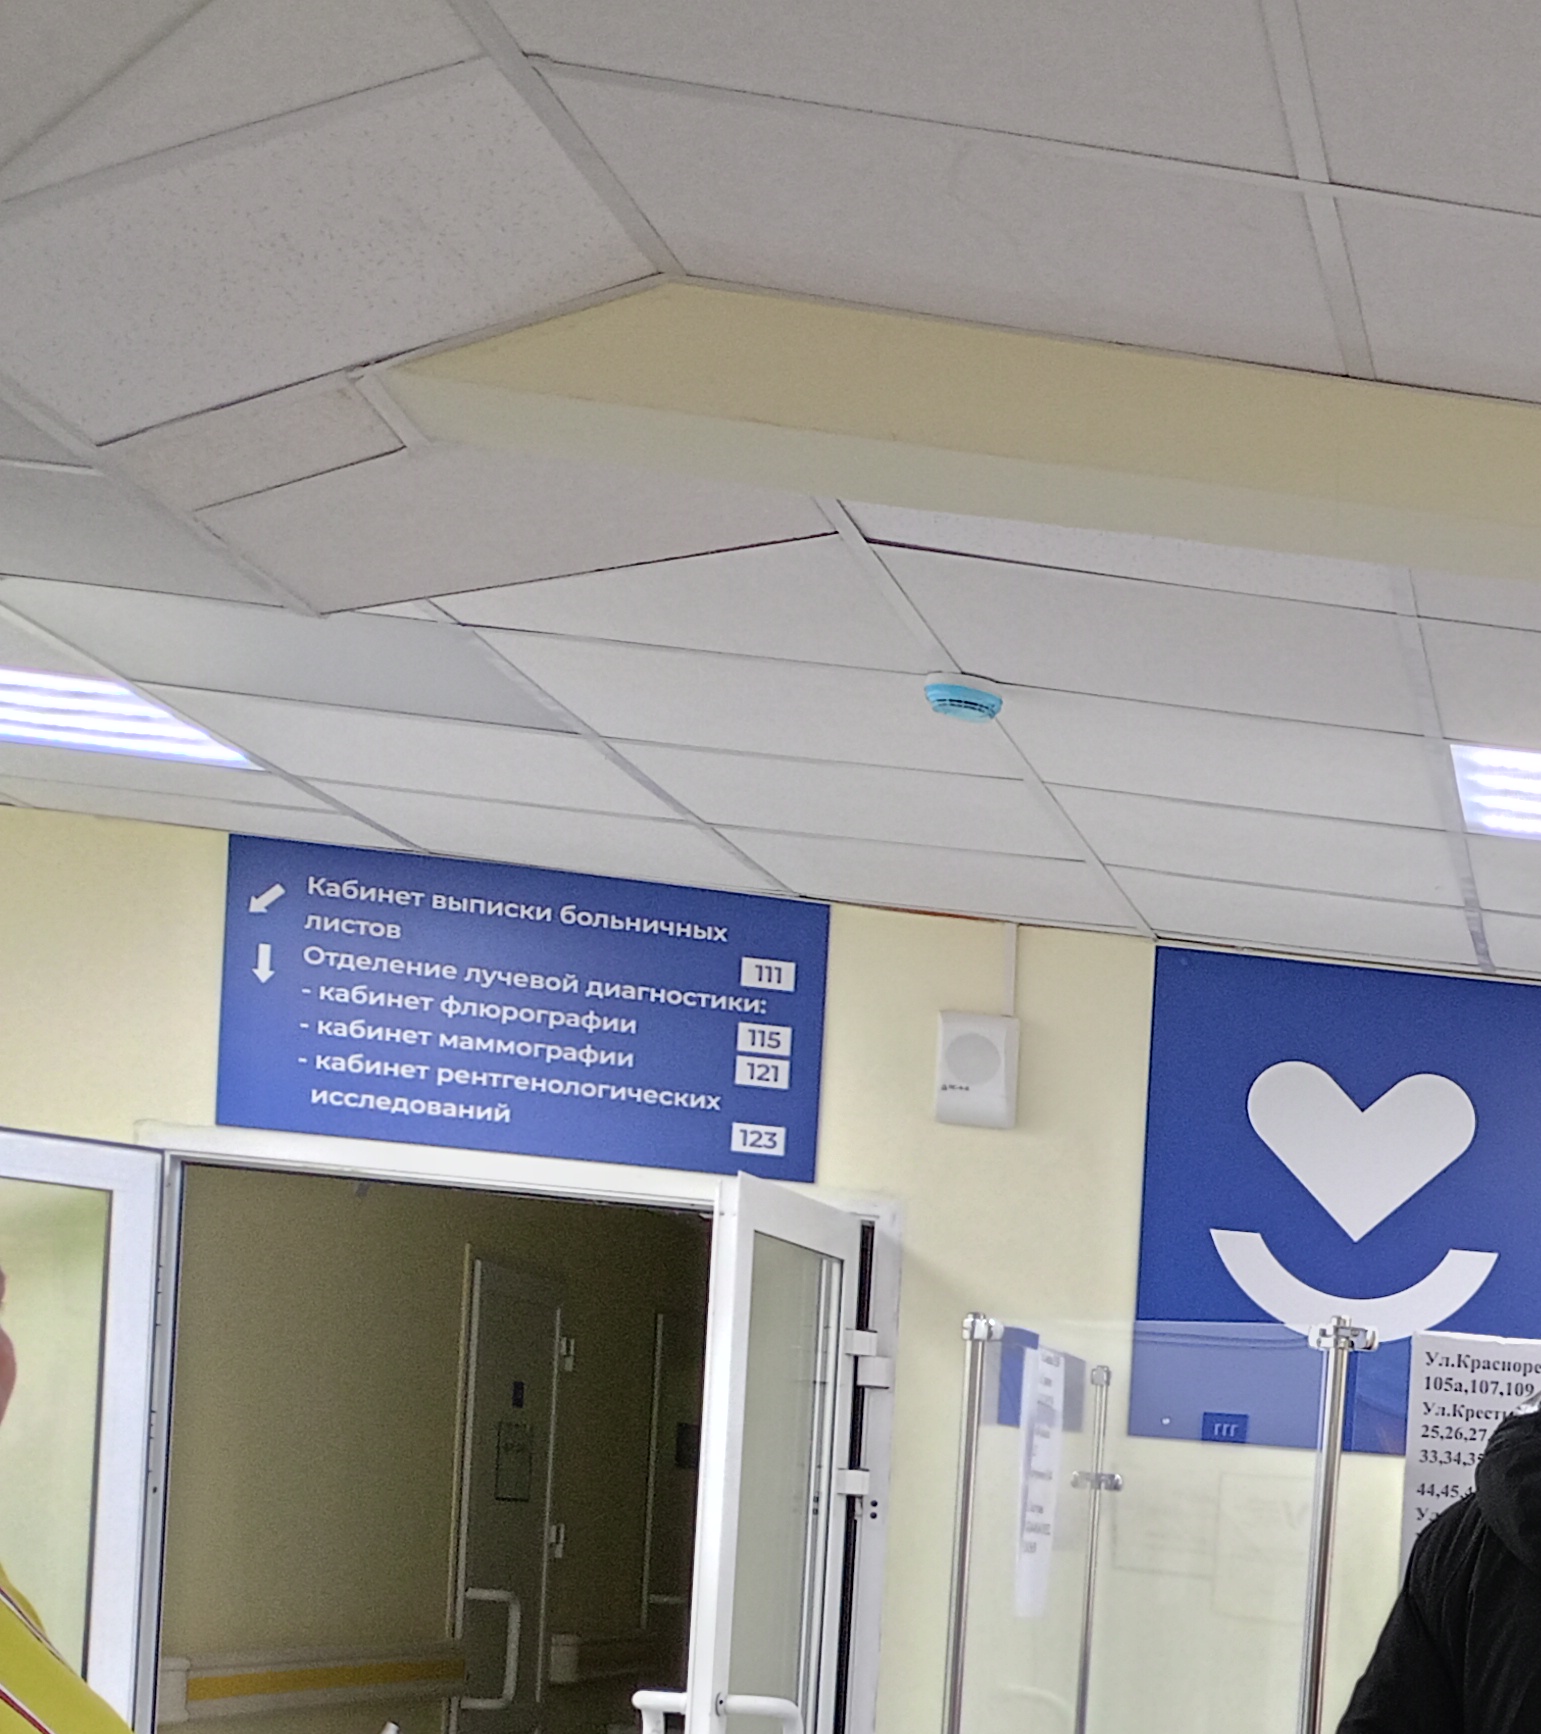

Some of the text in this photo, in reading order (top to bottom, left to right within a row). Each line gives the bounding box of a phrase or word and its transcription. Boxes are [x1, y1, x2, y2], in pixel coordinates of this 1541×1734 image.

[307, 876, 728, 942] Кабинет выписки больничных
[304, 914, 402, 939] листов
[303, 945, 767, 1014] Отделение лучевой диагностики:
[754, 964, 783, 984] 111
[319, 985, 434, 1012] кабинет
[440, 995, 637, 1034] флюрографии
[317, 1019, 433, 1046] кабинет
[438, 1033, 635, 1068] маммографии
[747, 1028, 782, 1049] 115
[315, 1054, 430, 1080] кабинет
[437, 1067, 722, 1111] рентгенологических
[746, 1063, 779, 1083] 121
[310, 1088, 511, 1123] исследований
[739, 1129, 778, 1150] 123
[1424, 1376, 1535, 1397] 105а,107,109
